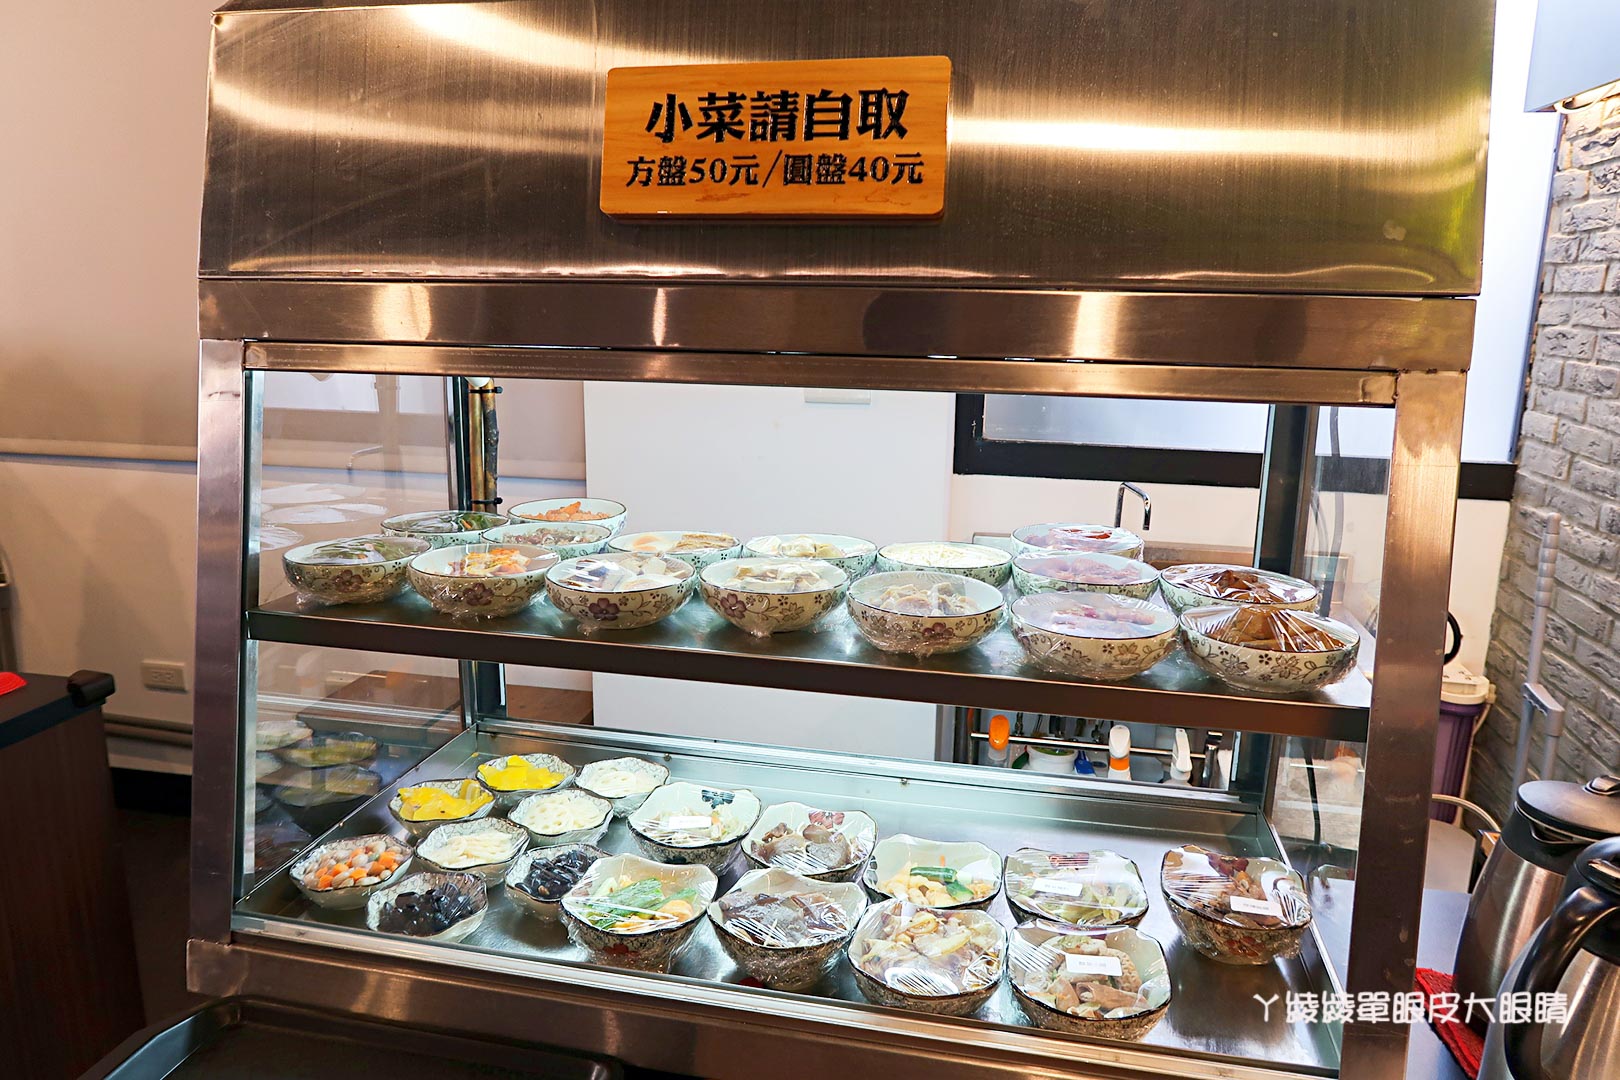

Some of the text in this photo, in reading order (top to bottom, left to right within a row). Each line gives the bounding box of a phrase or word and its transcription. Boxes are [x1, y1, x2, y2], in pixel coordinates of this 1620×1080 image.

[645, 87, 910, 143] 小菜請自取
[626, 150, 925, 188] 方盤50元/圓盤40元
